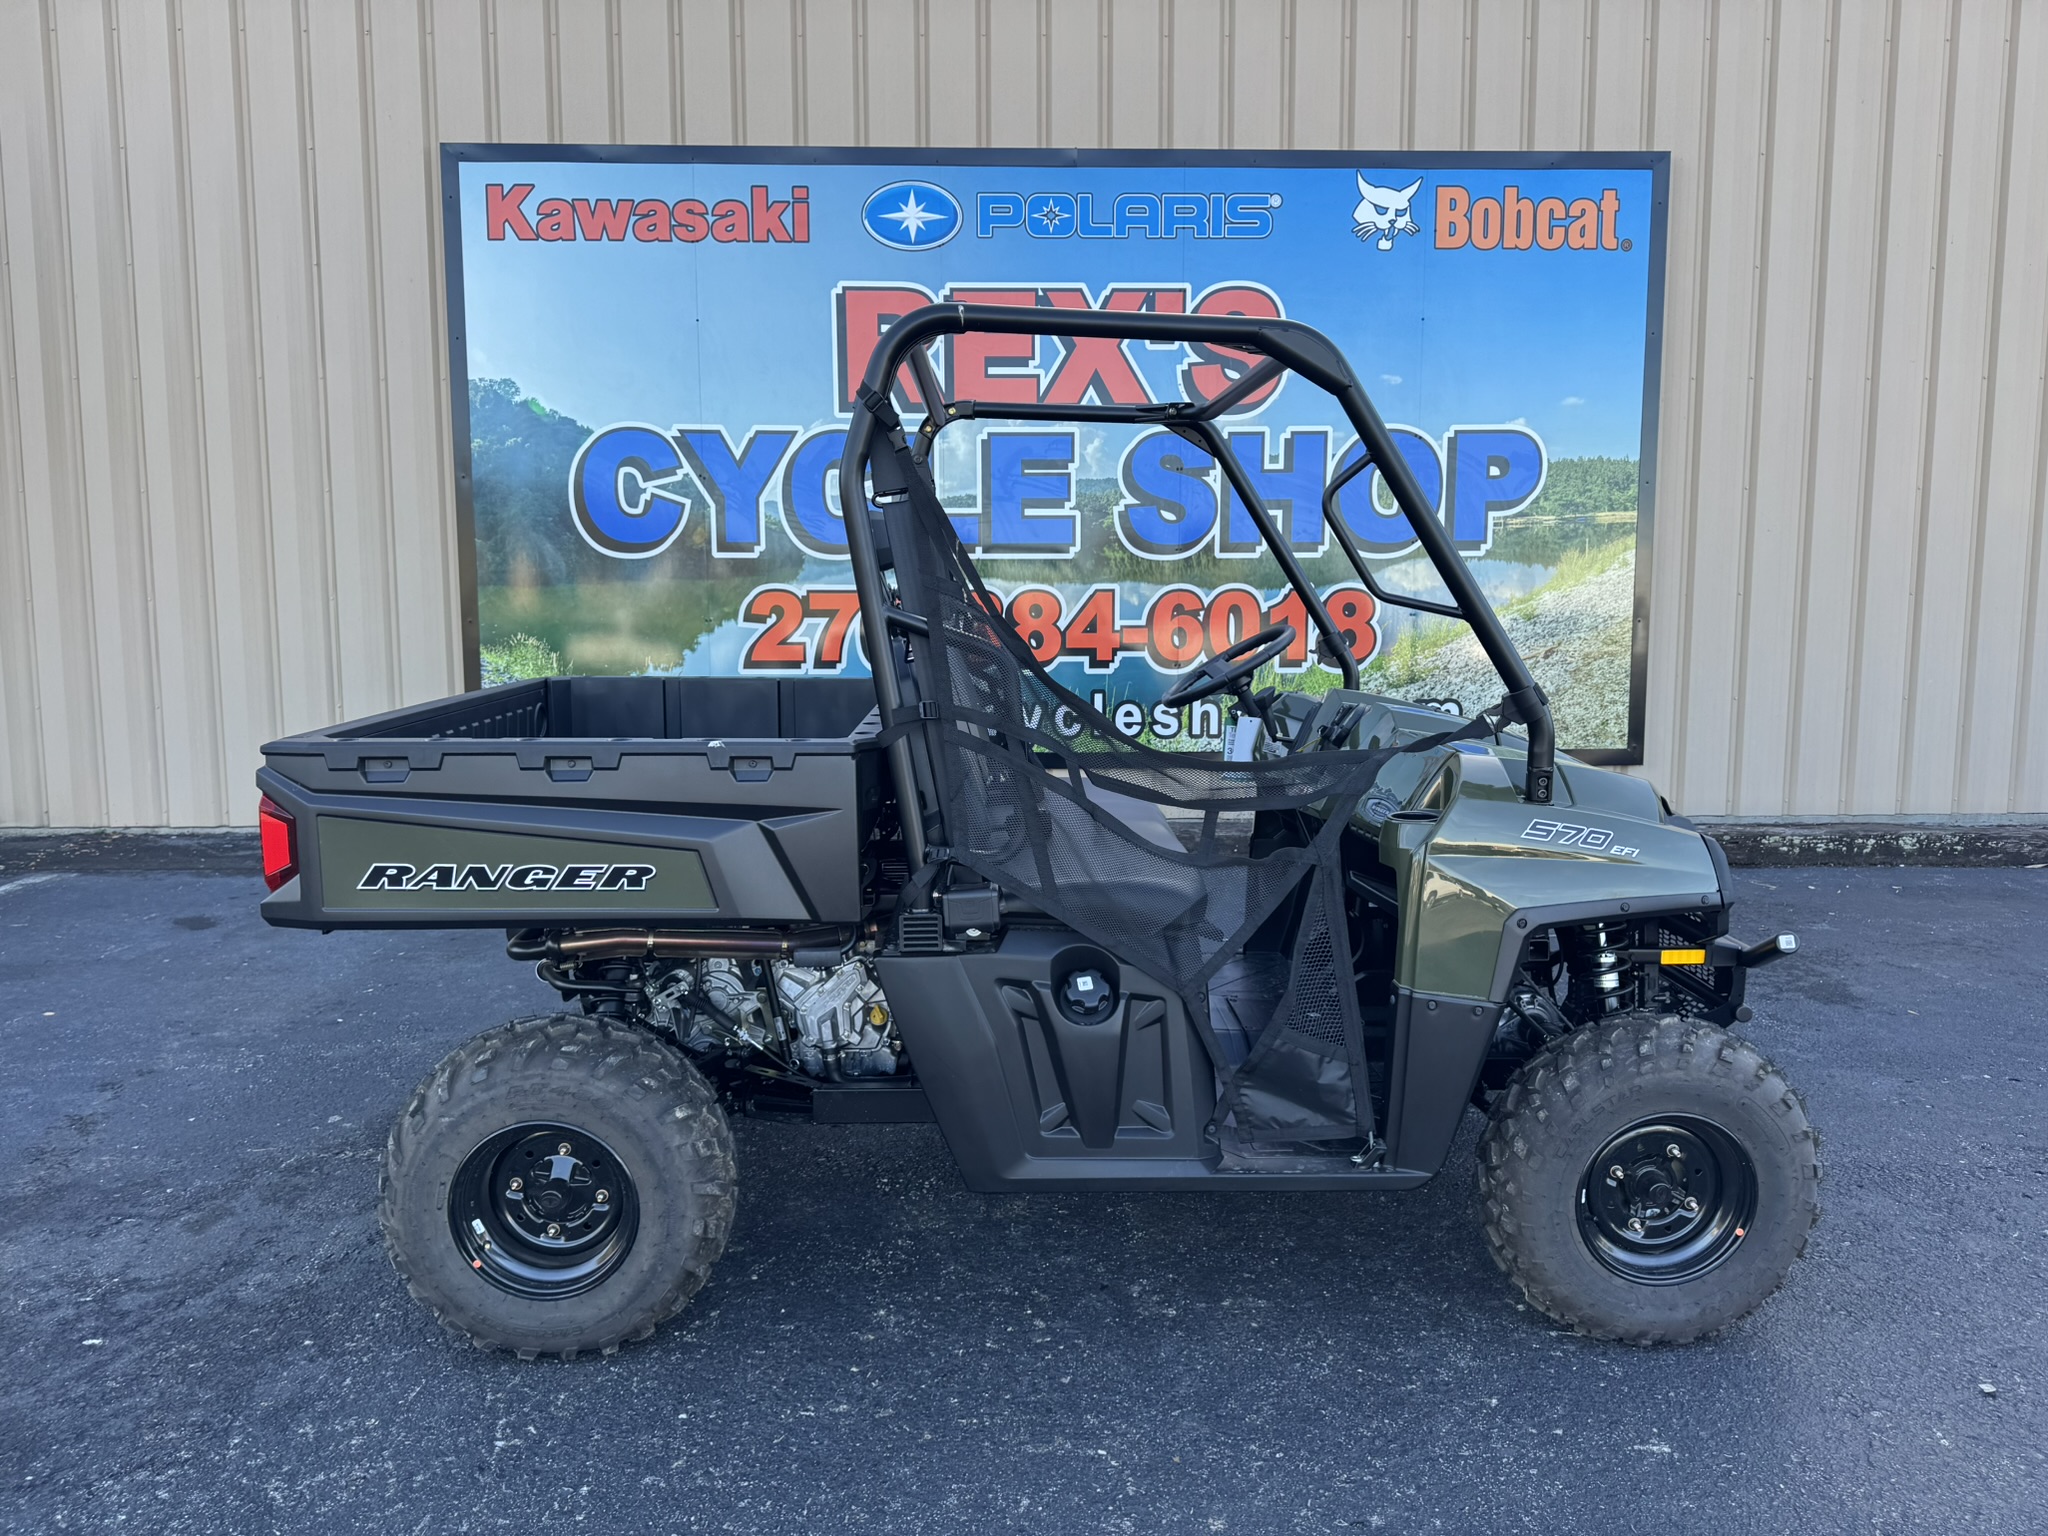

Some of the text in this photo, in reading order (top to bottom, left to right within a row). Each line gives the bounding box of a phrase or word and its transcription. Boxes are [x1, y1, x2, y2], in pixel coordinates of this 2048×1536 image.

[485, 183, 810, 243] Kawasaki
[976, 192, 1274, 240] POLARIS
[1433, 184, 1621, 251] Bobcat
[1113, 423, 1548, 560] SHOP
[1520, 818, 1641, 858] 570 EFI
[356, 862, 657, 892] RANGER
